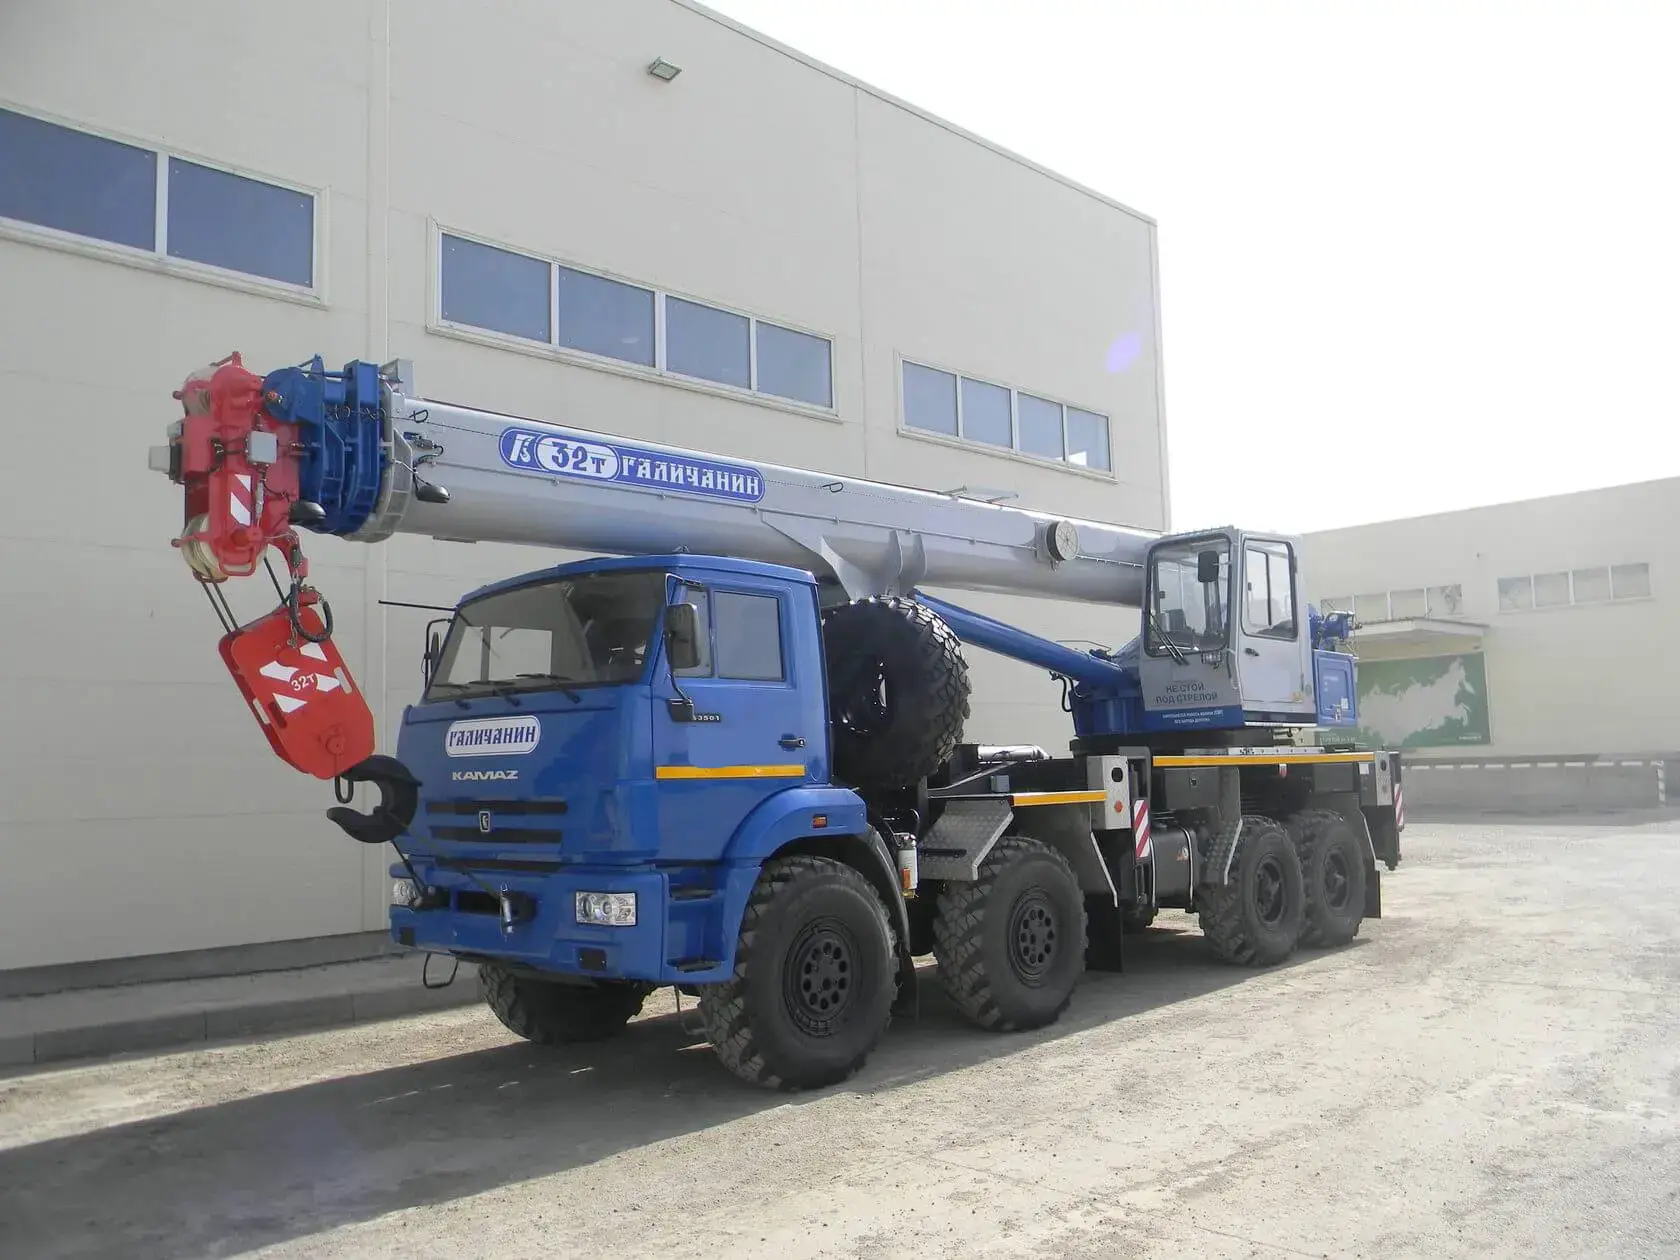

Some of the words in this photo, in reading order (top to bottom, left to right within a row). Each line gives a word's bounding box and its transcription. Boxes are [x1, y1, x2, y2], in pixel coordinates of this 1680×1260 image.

[622, 455, 759, 496] ГАЛИЧАНИН
[1155, 695, 1175, 704] ПОД
[449, 725, 536, 747] ГАЛИЧАНИН
[452, 770, 519, 780] KAMAZ
